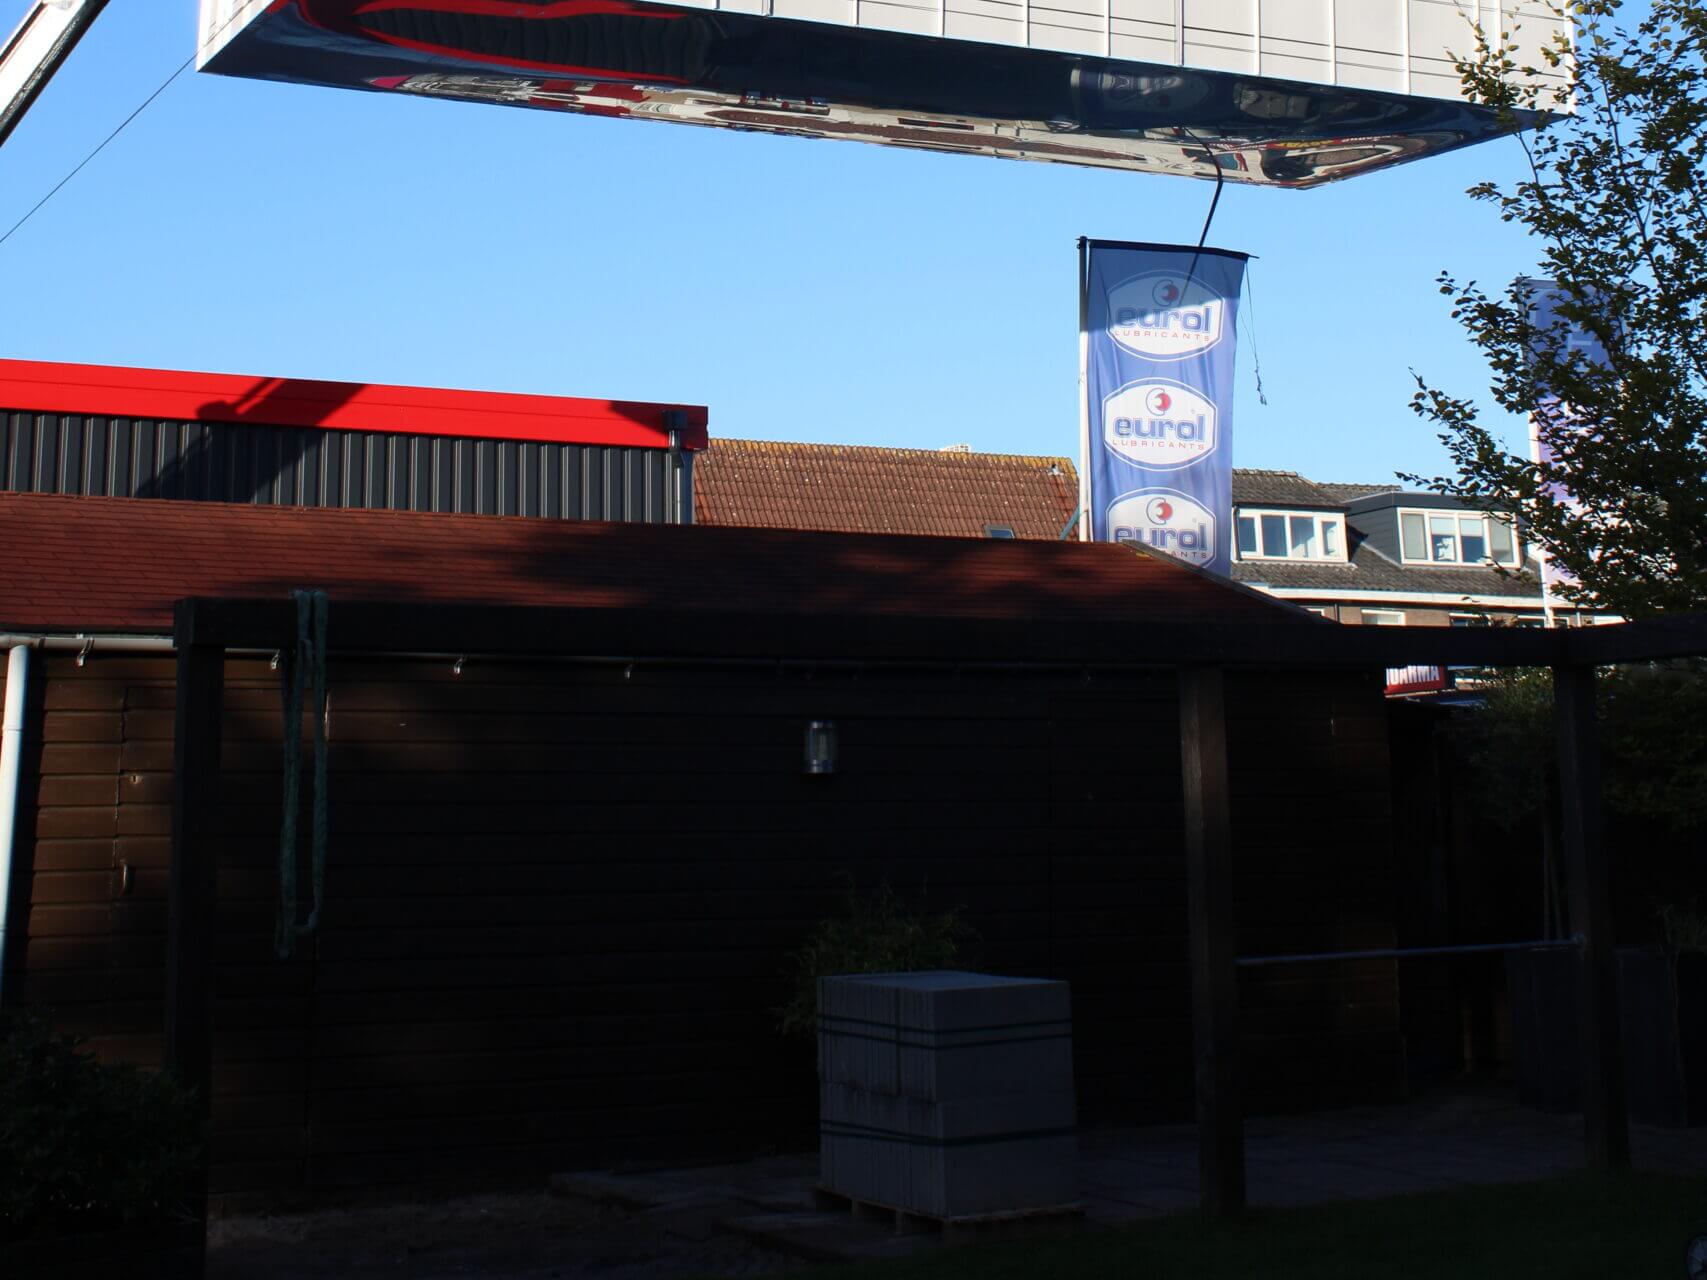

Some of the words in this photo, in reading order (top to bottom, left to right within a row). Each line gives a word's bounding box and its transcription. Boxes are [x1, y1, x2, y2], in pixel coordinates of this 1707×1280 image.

[1115, 306, 1212, 333] eurol
[1114, 330, 1210, 342] LUBRICANTS
[1114, 414, 1206, 442] eurol
[1112, 440, 1204, 450] LUBRICANTS
